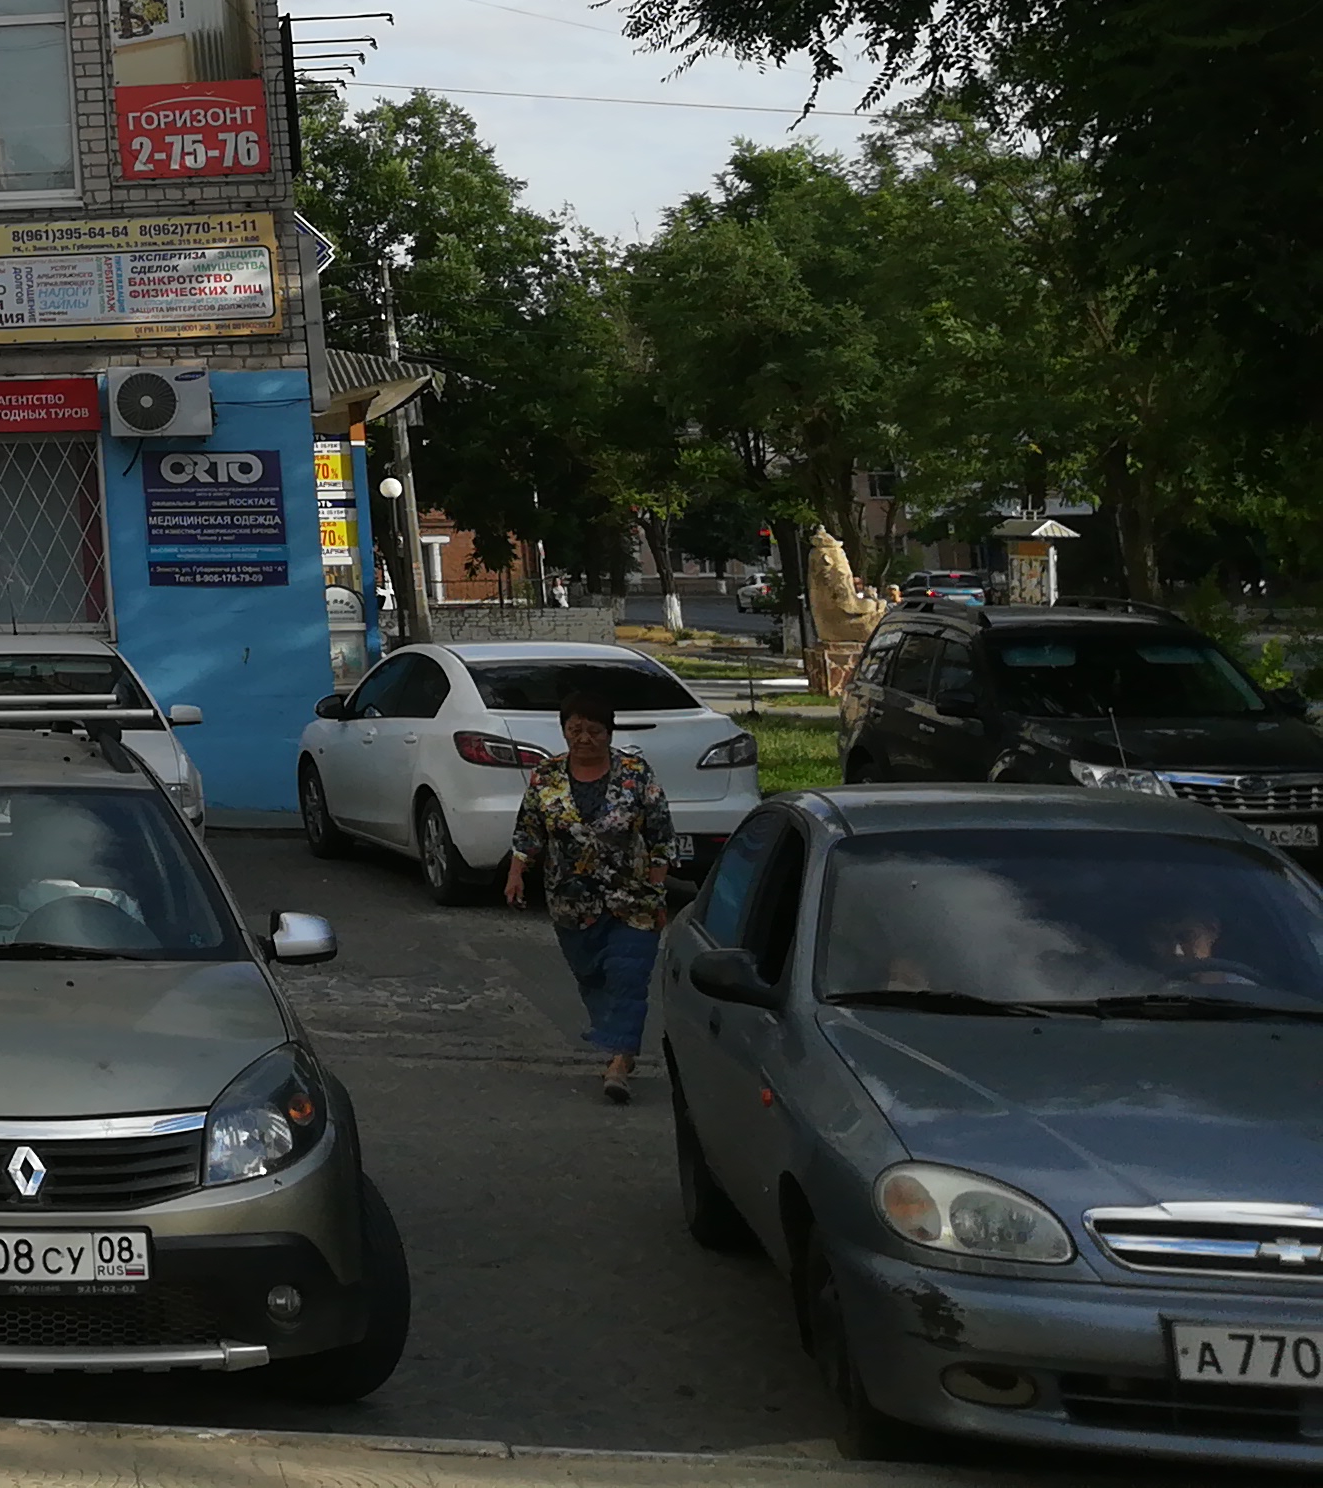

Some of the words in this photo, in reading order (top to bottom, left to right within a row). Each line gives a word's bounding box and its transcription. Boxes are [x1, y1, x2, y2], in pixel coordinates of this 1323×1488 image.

[128, 105, 256, 131] ГОРИЗОНТ
[133, 130, 261, 172] 2-75-76
[12, 225, 129, 244] 8(961)395-64-64
[139, 219, 257, 239] 8(962)770-11-11
[129, 252, 207, 263] ЭКСПЕРТИЗА
[217, 250, 265, 260] ЗАЩИТА
[130, 264, 179, 275] СДЕЛОК
[192, 262, 267, 273] ИМУЩЕСТВА
[13, 266, 24, 305] ДОЛГОВ
[104, 256, 116, 312] АРБИТРАЖ
[128, 273, 233, 287] БАНКРОТСТВО
[25, 266, 37, 323] ПОГАШЕНИЕ
[129, 286, 228, 299] ФИЗИЧЕСКИХ
[232, 283, 264, 297] ЛИЦ
[165, 304, 216, 313] ИНТЕРЕСОВ
[217, 302, 267, 311] ДОЛЖНИКА
[49, 407, 90, 419] ТУРОВ
[160, 453, 263, 484] ORTO
[229, 497, 276, 506] ROCKTAPE
[148, 515, 231, 526] МЕДИЦИНСКАЯ
[233, 515, 282, 526] ОДЕЖДА
[97, 1235, 135, 1263] 08
[97, 1264, 124, 1276] RUS
